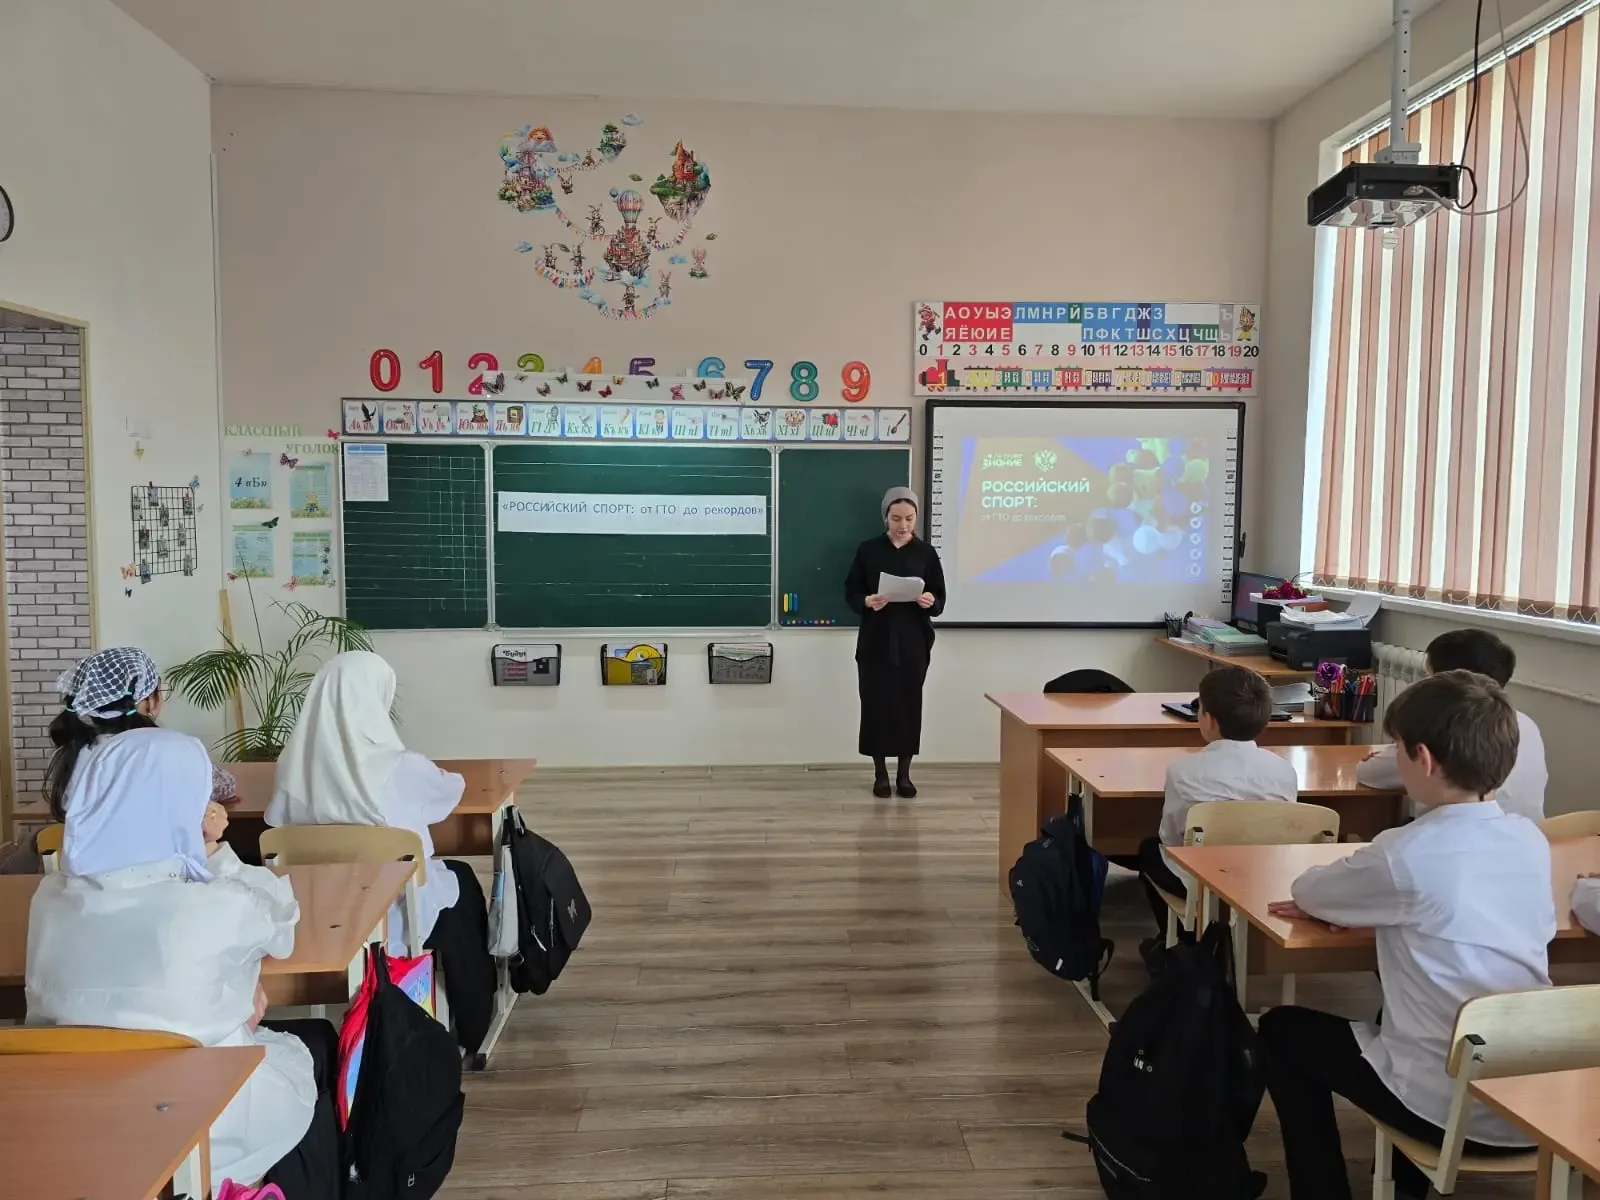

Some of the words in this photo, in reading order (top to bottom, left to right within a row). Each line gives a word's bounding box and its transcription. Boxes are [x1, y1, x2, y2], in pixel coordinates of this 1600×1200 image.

[919, 344, 927, 356] 0
[938, 344, 944, 356] 1
[953, 344, 961, 356] 2
[969, 344, 977, 356] 3
[985, 344, 993, 356] 4
[1001, 344, 1009, 356] 5
[1018, 344, 1026, 356] 6
[1035, 344, 1042, 356] 7
[1051, 344, 1060, 356] 8
[1067, 344, 1076, 356] 9
[1081, 344, 1095, 356] 10
[1099, 344, 1111, 356] 11
[1114, 344, 1128, 356] 12
[1131, 344, 1144, 356] 13
[1146, 344, 1161, 356] 14
[1163, 344, 1176, 356] 15
[1180, 344, 1193, 356] 16
[1196, 344, 1209, 356] 17
[1212, 344, 1225, 356] 18
[1228, 344, 1242, 356] 19
[1244, 344, 1258, 356] 20
[370, 349, 400, 392] 0
[419, 350, 443, 393] 1
[745, 360, 773, 401] 7
[789, 361, 819, 402] 8
[842, 360, 871, 403] 9
[235, 477, 243, 488] 4
[982, 477, 1090, 493] РОССИЙСКИЙ
[502, 501, 587, 513] «РОССИЙСКИЙ
[593, 504, 634, 515] СПОРТ:
[656, 505, 676, 515] ГТО
[683, 507, 698, 517] до
[981, 496, 1038, 509] СПОРТ:
